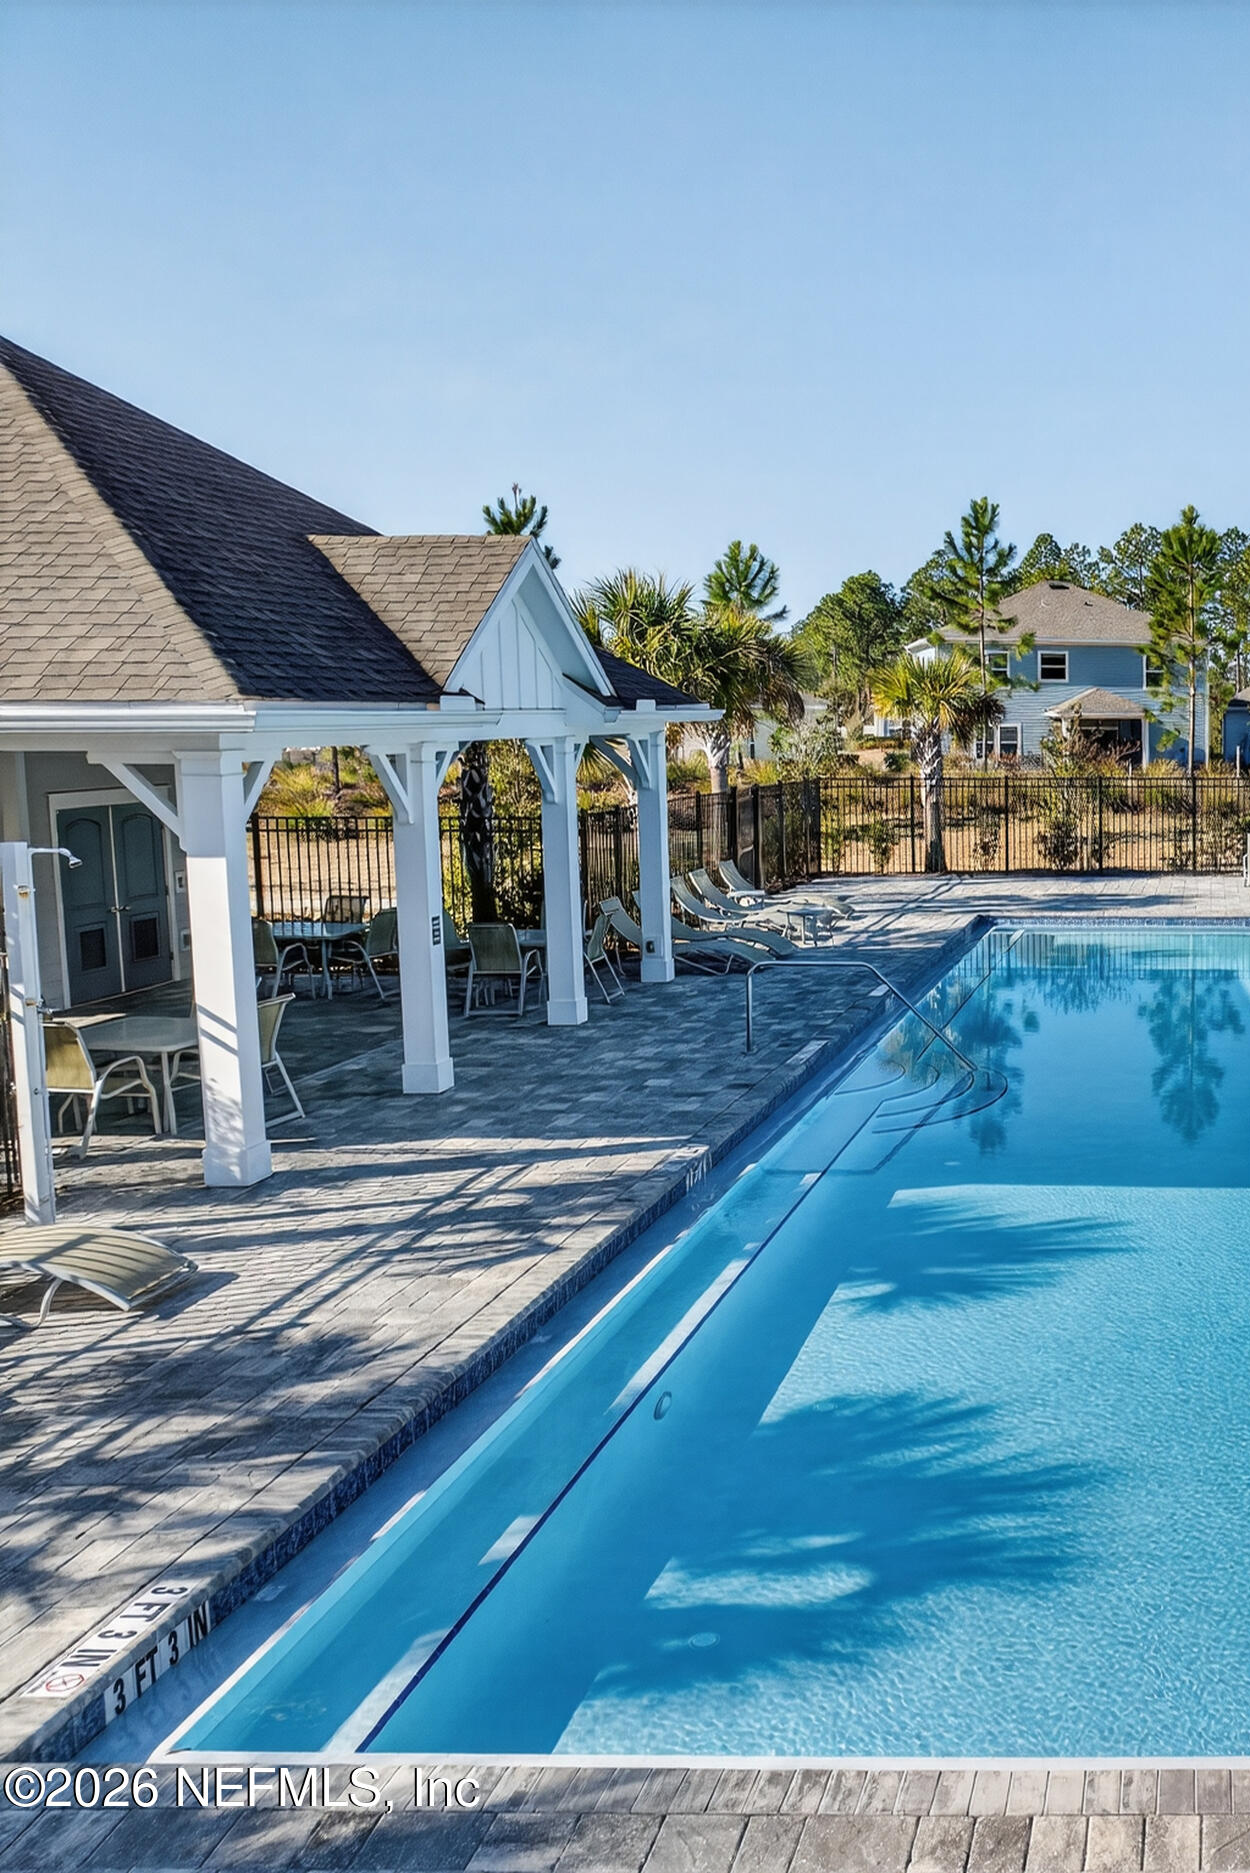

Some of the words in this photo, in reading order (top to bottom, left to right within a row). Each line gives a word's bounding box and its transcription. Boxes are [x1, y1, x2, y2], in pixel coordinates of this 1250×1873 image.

[151, 1586, 188, 1595] 3
[119, 1602, 171, 1622] FT
[97, 1630, 138, 1640] 3
[60, 1649, 117, 1667] IN
[113, 1678, 126, 1715] 3
[134, 1648, 158, 1698] FT
[168, 1630, 179, 1666] 3
[186, 1604, 208, 1649] IN
